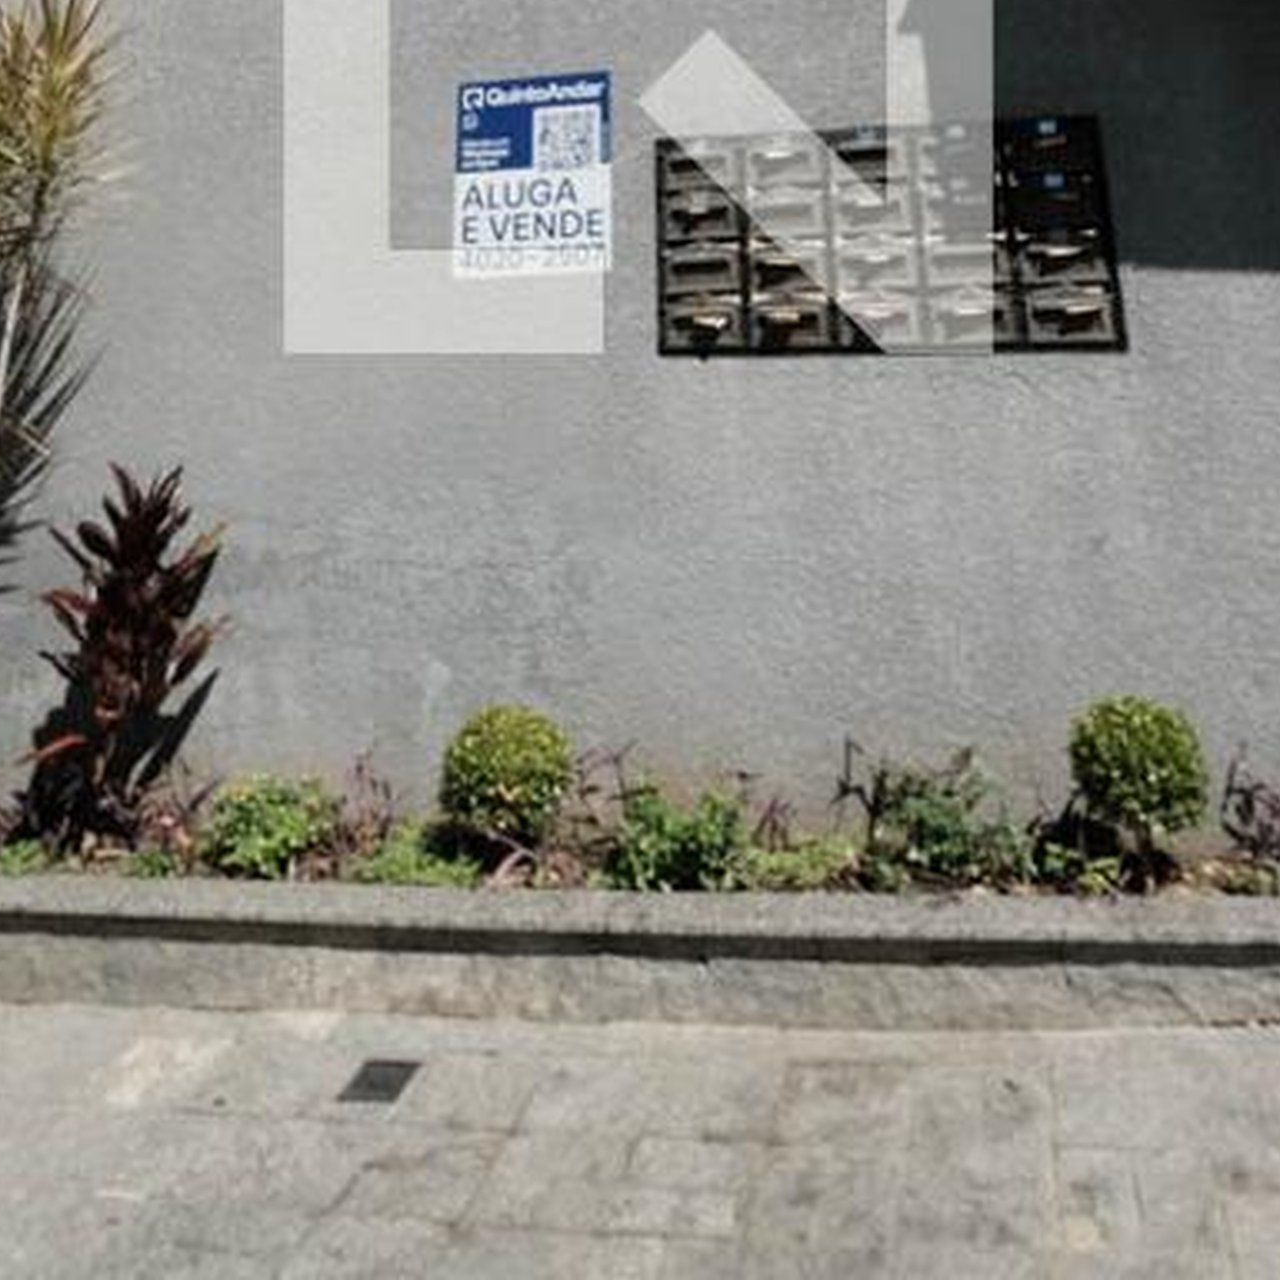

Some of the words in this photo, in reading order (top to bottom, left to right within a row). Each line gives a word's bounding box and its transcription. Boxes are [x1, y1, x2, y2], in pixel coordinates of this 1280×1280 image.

[462, 177, 578, 211] ALUGA
[462, 216, 479, 244] E
[489, 210, 603, 242] VENDE
